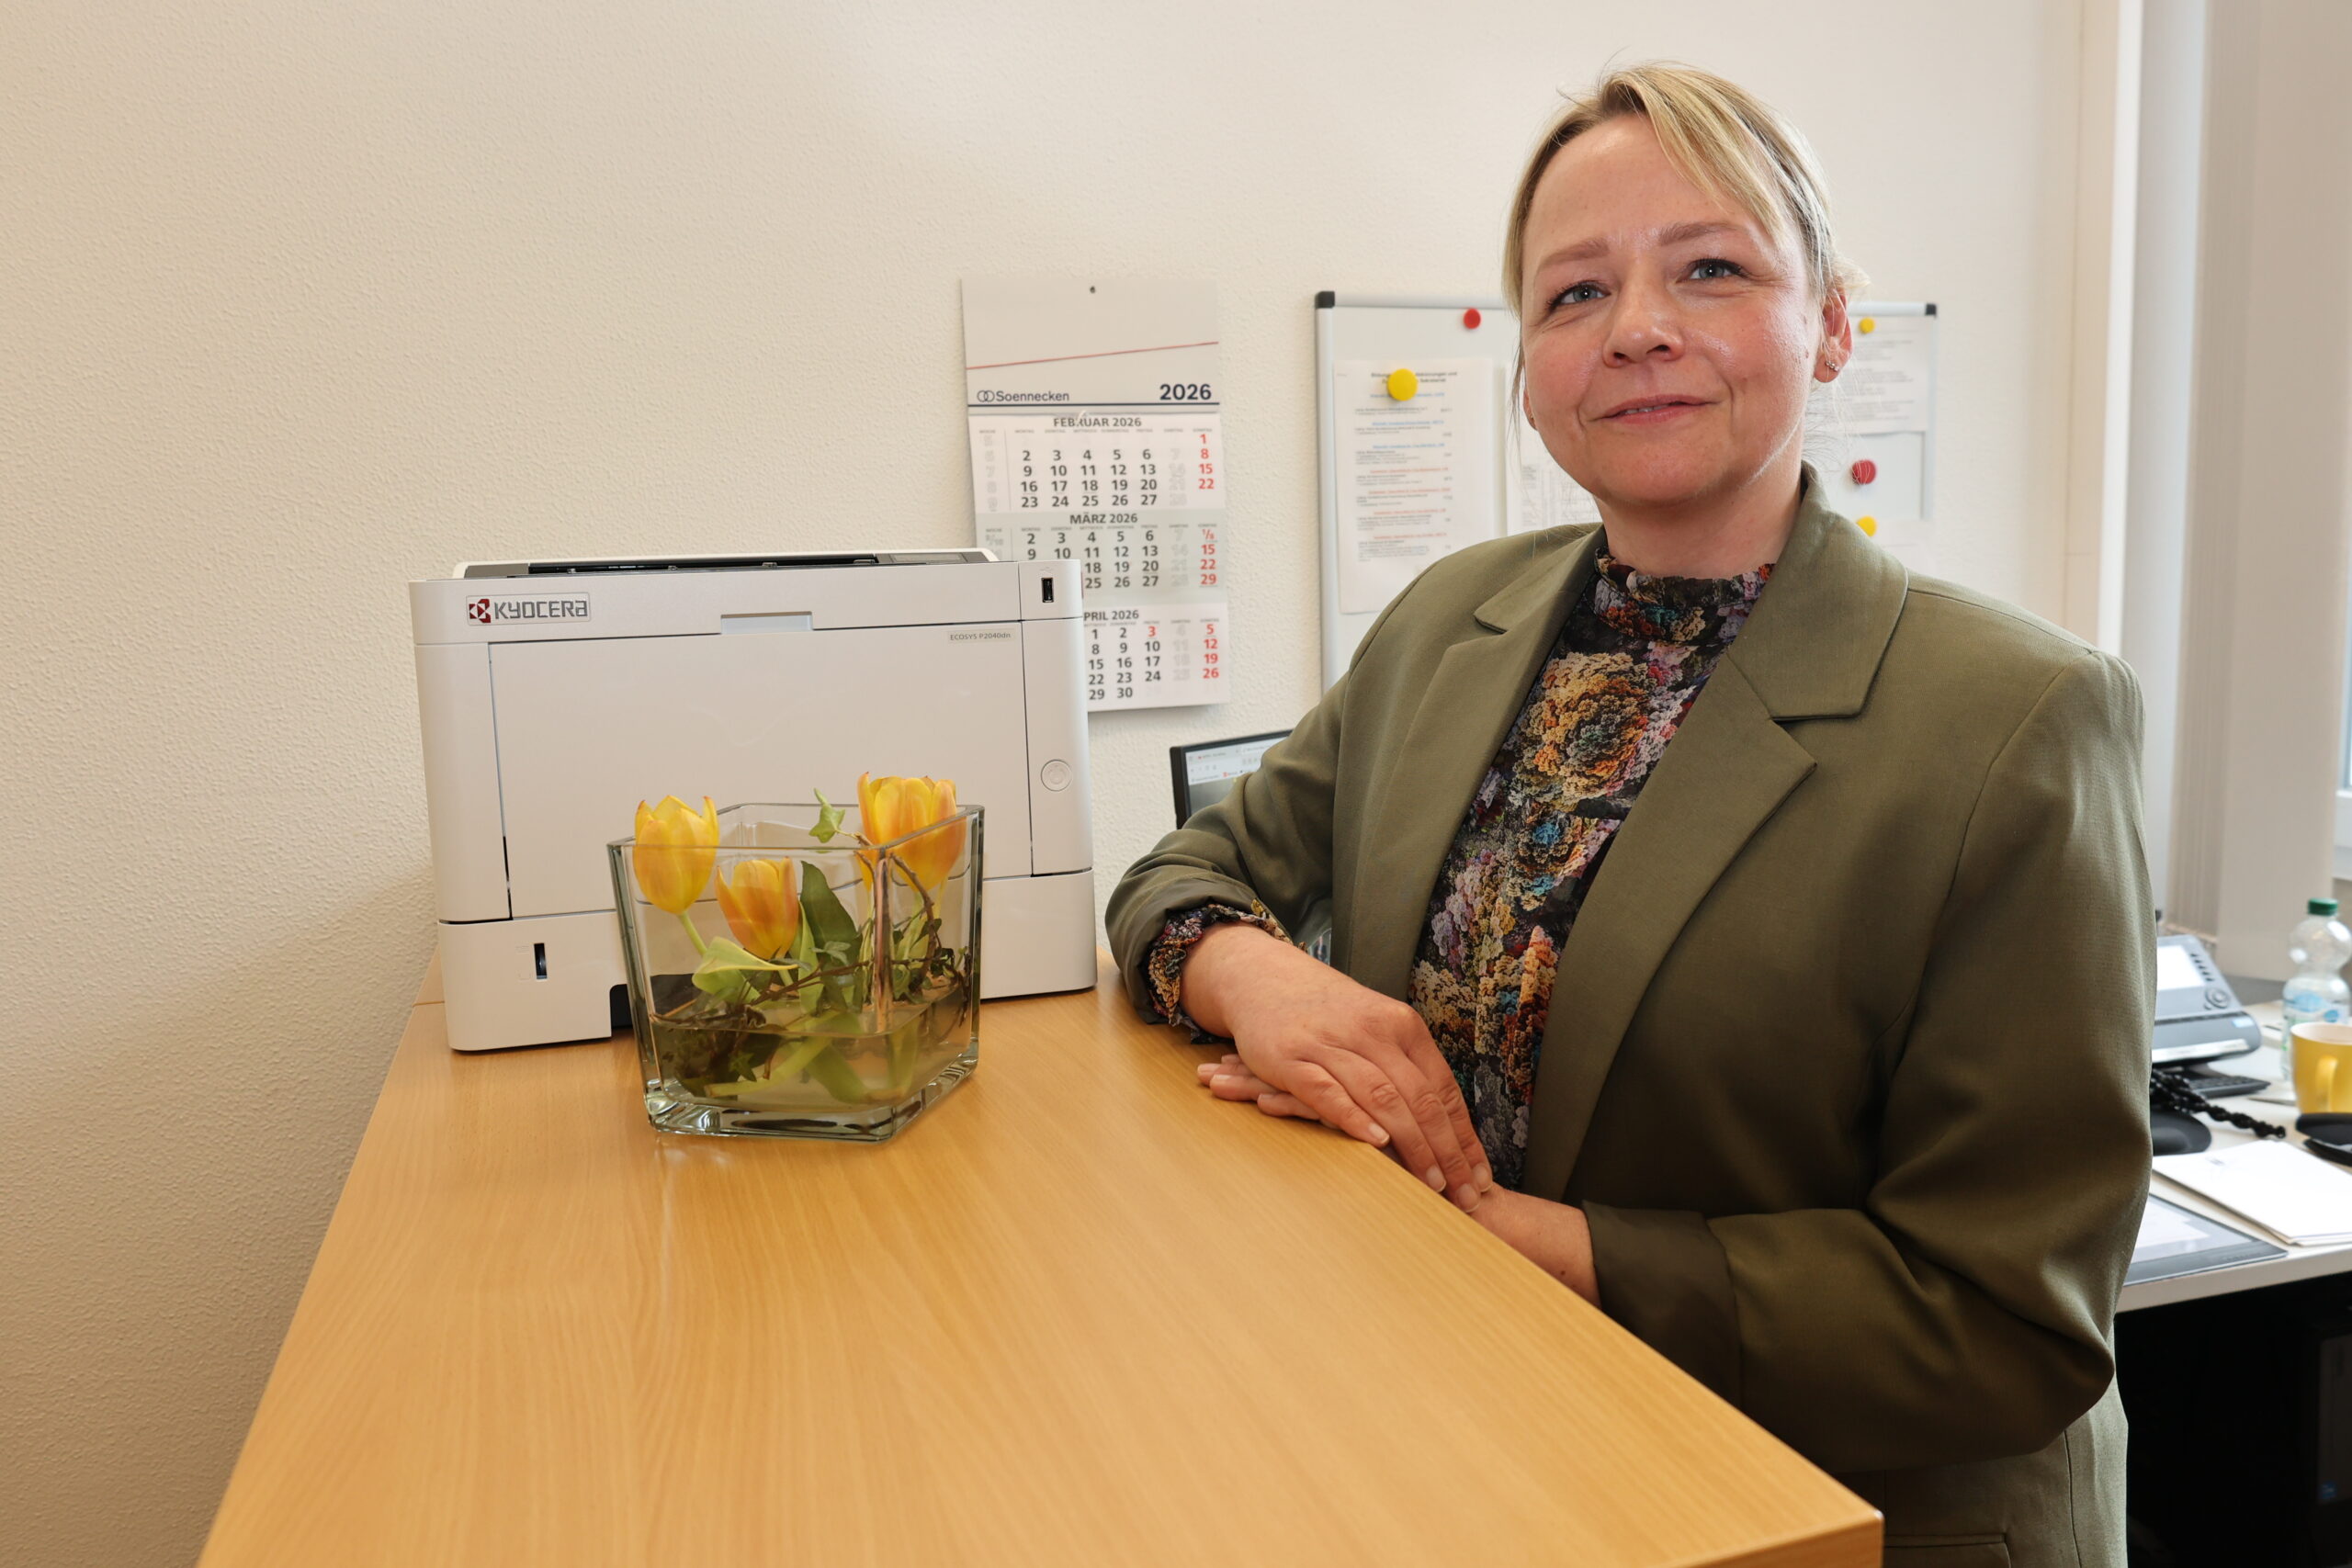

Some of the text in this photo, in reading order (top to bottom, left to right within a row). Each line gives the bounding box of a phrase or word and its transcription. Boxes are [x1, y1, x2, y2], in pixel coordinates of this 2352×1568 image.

[995, 383, 1212, 401] Soennecken 2026
[1113, 417, 1142, 427] 2026
[1199, 433, 1207, 445] 1
[1023, 449, 1031, 462] 2
[1053, 449, 1062, 461] 3
[1082, 449, 1092, 460] 4
[1113, 448, 1122, 461] 5
[1142, 448, 1151, 460] 6
[1200, 447, 1210, 460] 8
[1023, 465, 1033, 477] 9
[1050, 465, 1068, 477] 10
[1080, 464, 1096, 476] 11
[1110, 464, 1127, 476] 12
[1140, 463, 1157, 476] 13
[1199, 463, 1214, 475] 15
[1021, 480, 1038, 492] 16
[1051, 479, 1068, 492] 17
[1081, 479, 1099, 491] 18
[1112, 479, 1128, 491] 19
[1140, 479, 1158, 491] 20
[1198, 478, 1215, 490] 22
[1021, 496, 1038, 508] 23
[1052, 495, 1069, 507] 24
[1082, 494, 1099, 507] 25
[1112, 494, 1129, 506] 26
[1140, 493, 1158, 506] 27
[1069, 512, 1138, 525] MÄRZ 2026
[1027, 533, 1035, 545] 2
[1057, 532, 1066, 545] 3
[1087, 531, 1096, 543] 4
[1116, 530, 1125, 543] 5
[1145, 529, 1155, 542] 6
[1027, 548, 1036, 560] 9
[1054, 547, 1071, 559] 10
[1084, 547, 1100, 558] 11
[1114, 546, 1129, 558] 12
[1142, 545, 1159, 557] 13
[1201, 543, 1216, 556] 15
[1084, 561, 1102, 574] 18
[1114, 560, 1130, 573] 19
[1142, 559, 1159, 572] 20
[1200, 558, 1216, 570] 22
[1085, 577, 1102, 589] 25
[1114, 576, 1131, 588] 26
[1142, 575, 1159, 587] 27
[1201, 573, 1217, 585] 29
[1083, 609, 1140, 621] PRIL 2026
[1091, 628, 1099, 639] 1
[1119, 626, 1127, 638] 2
[1148, 626, 1157, 637] 3
[1206, 624, 1215, 636] 5
[1091, 643, 1101, 655] 8
[1119, 642, 1128, 654] 9
[1145, 640, 1160, 652] 10
[1204, 638, 1218, 649] 12
[1088, 659, 1104, 670] 15
[1116, 657, 1133, 669] 16
[1145, 655, 1160, 667] 17
[1204, 652, 1219, 664] 19
[1089, 673, 1104, 685] 22
[1116, 671, 1133, 683] 23
[1145, 671, 1161, 682] 24
[1203, 667, 1220, 680] 26
[1089, 686, 1134, 701] 29 30
